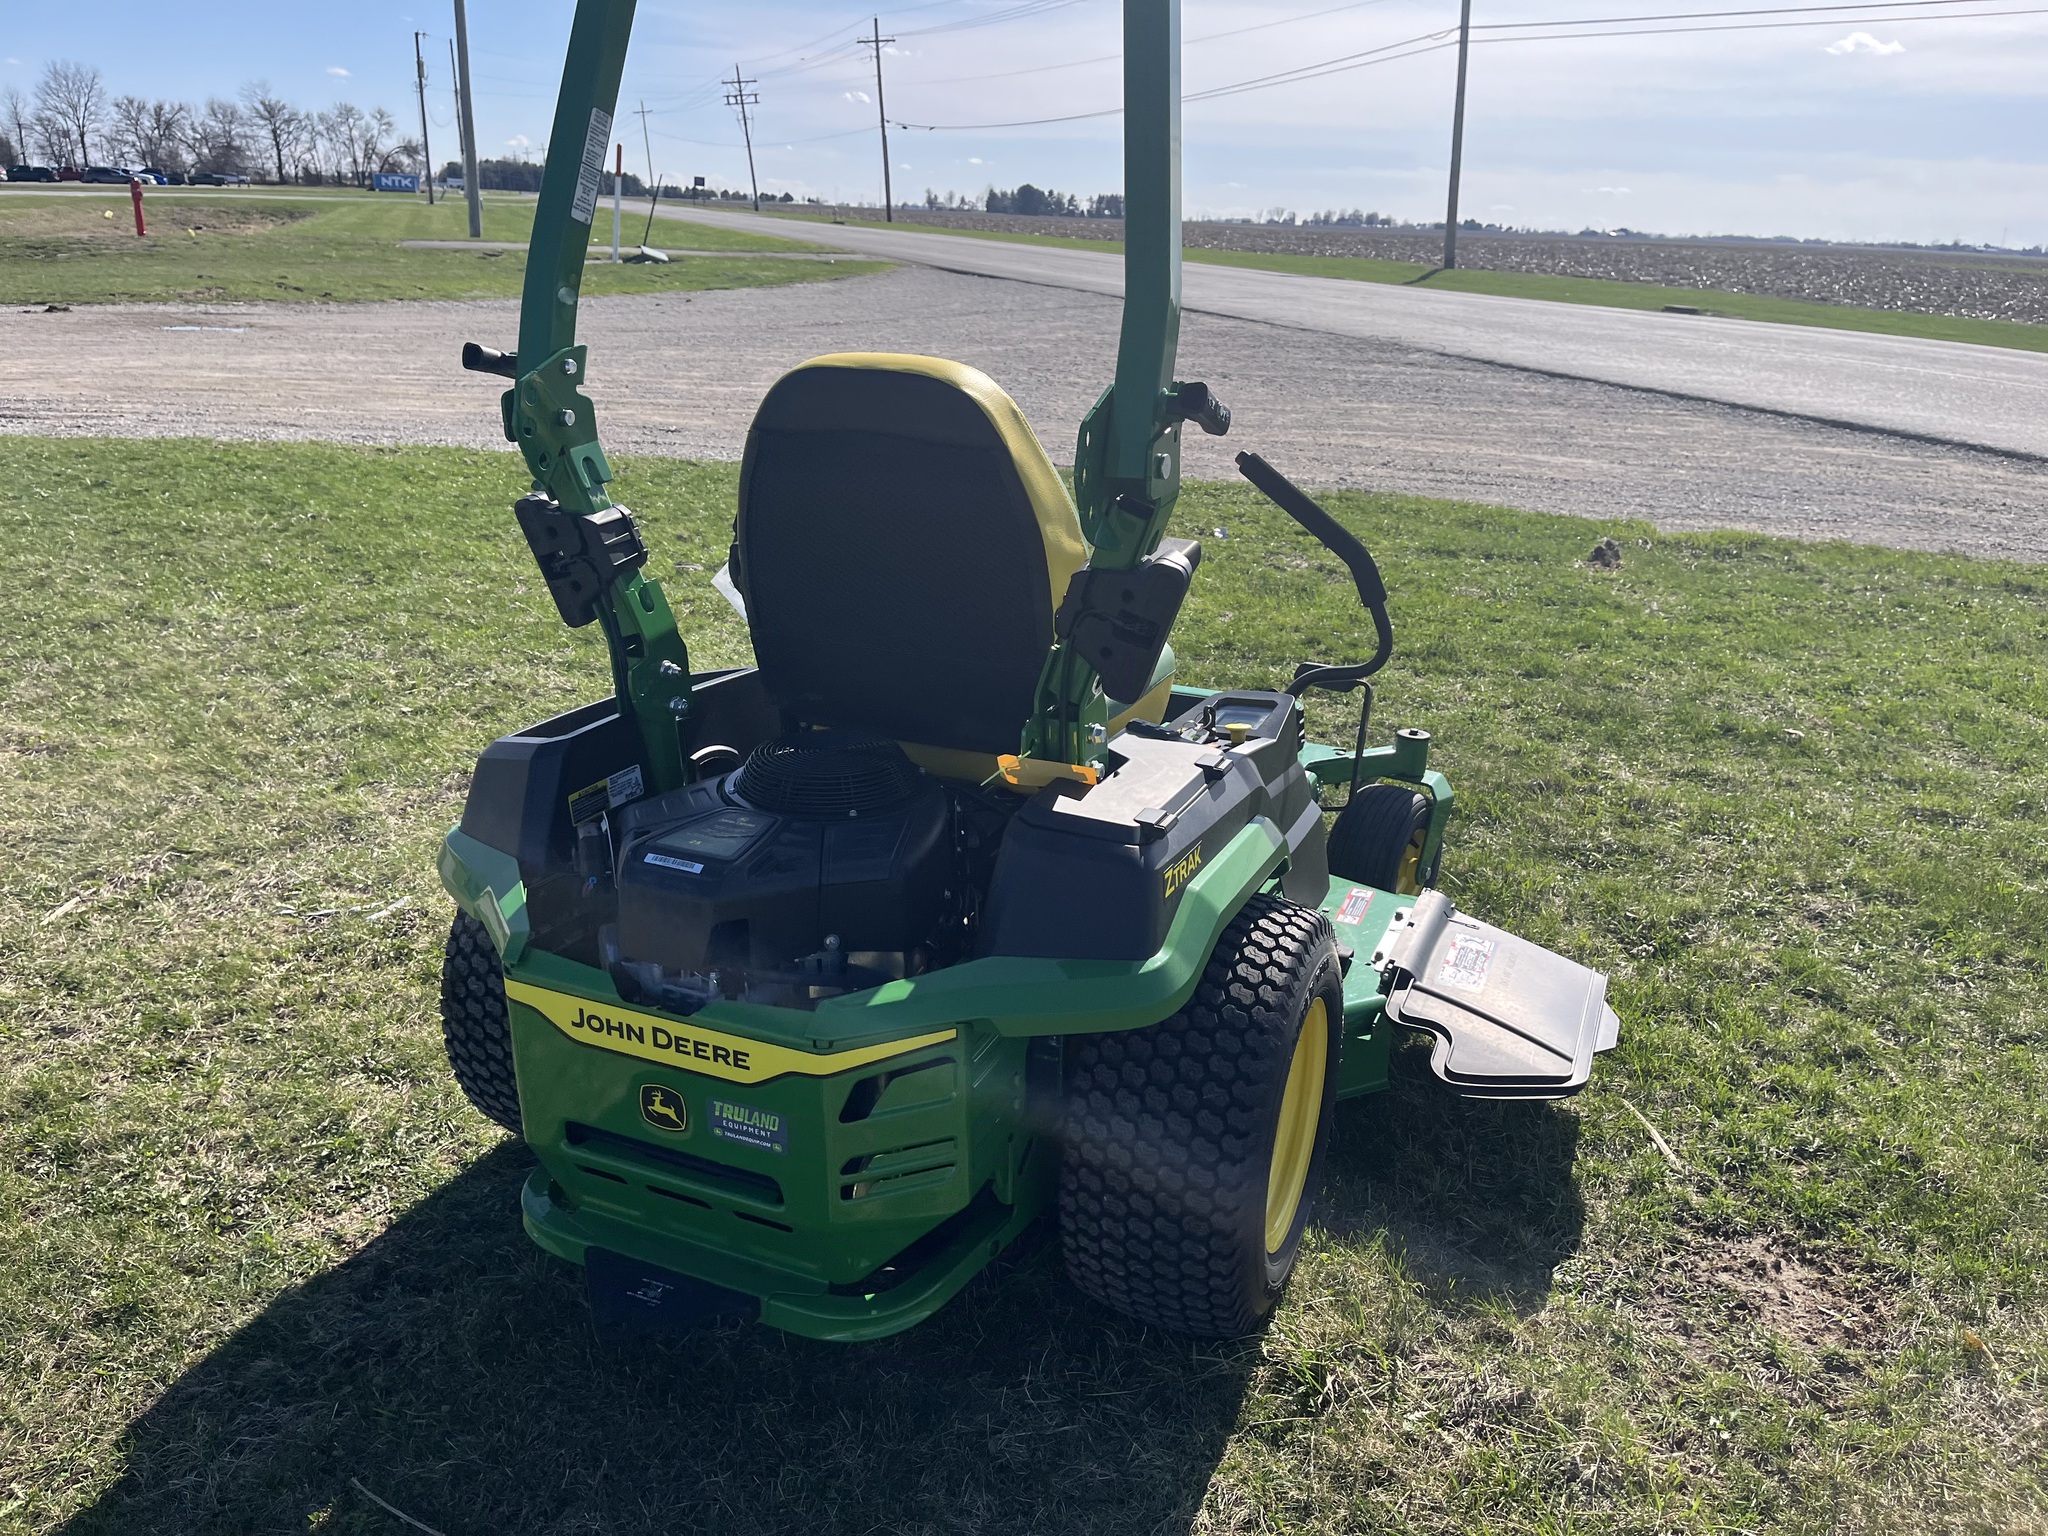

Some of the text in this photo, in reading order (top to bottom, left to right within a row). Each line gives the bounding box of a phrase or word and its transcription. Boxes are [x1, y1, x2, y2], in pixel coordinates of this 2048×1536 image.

[381, 176, 412, 188] NTK
[571, 1007, 751, 1071] JOHN DEERE
[713, 1100, 779, 1131] TRULAND
[722, 1120, 771, 1138] EQUIPMENT
[723, 1131, 772, 1148] TRULANDEQUIP.COM
